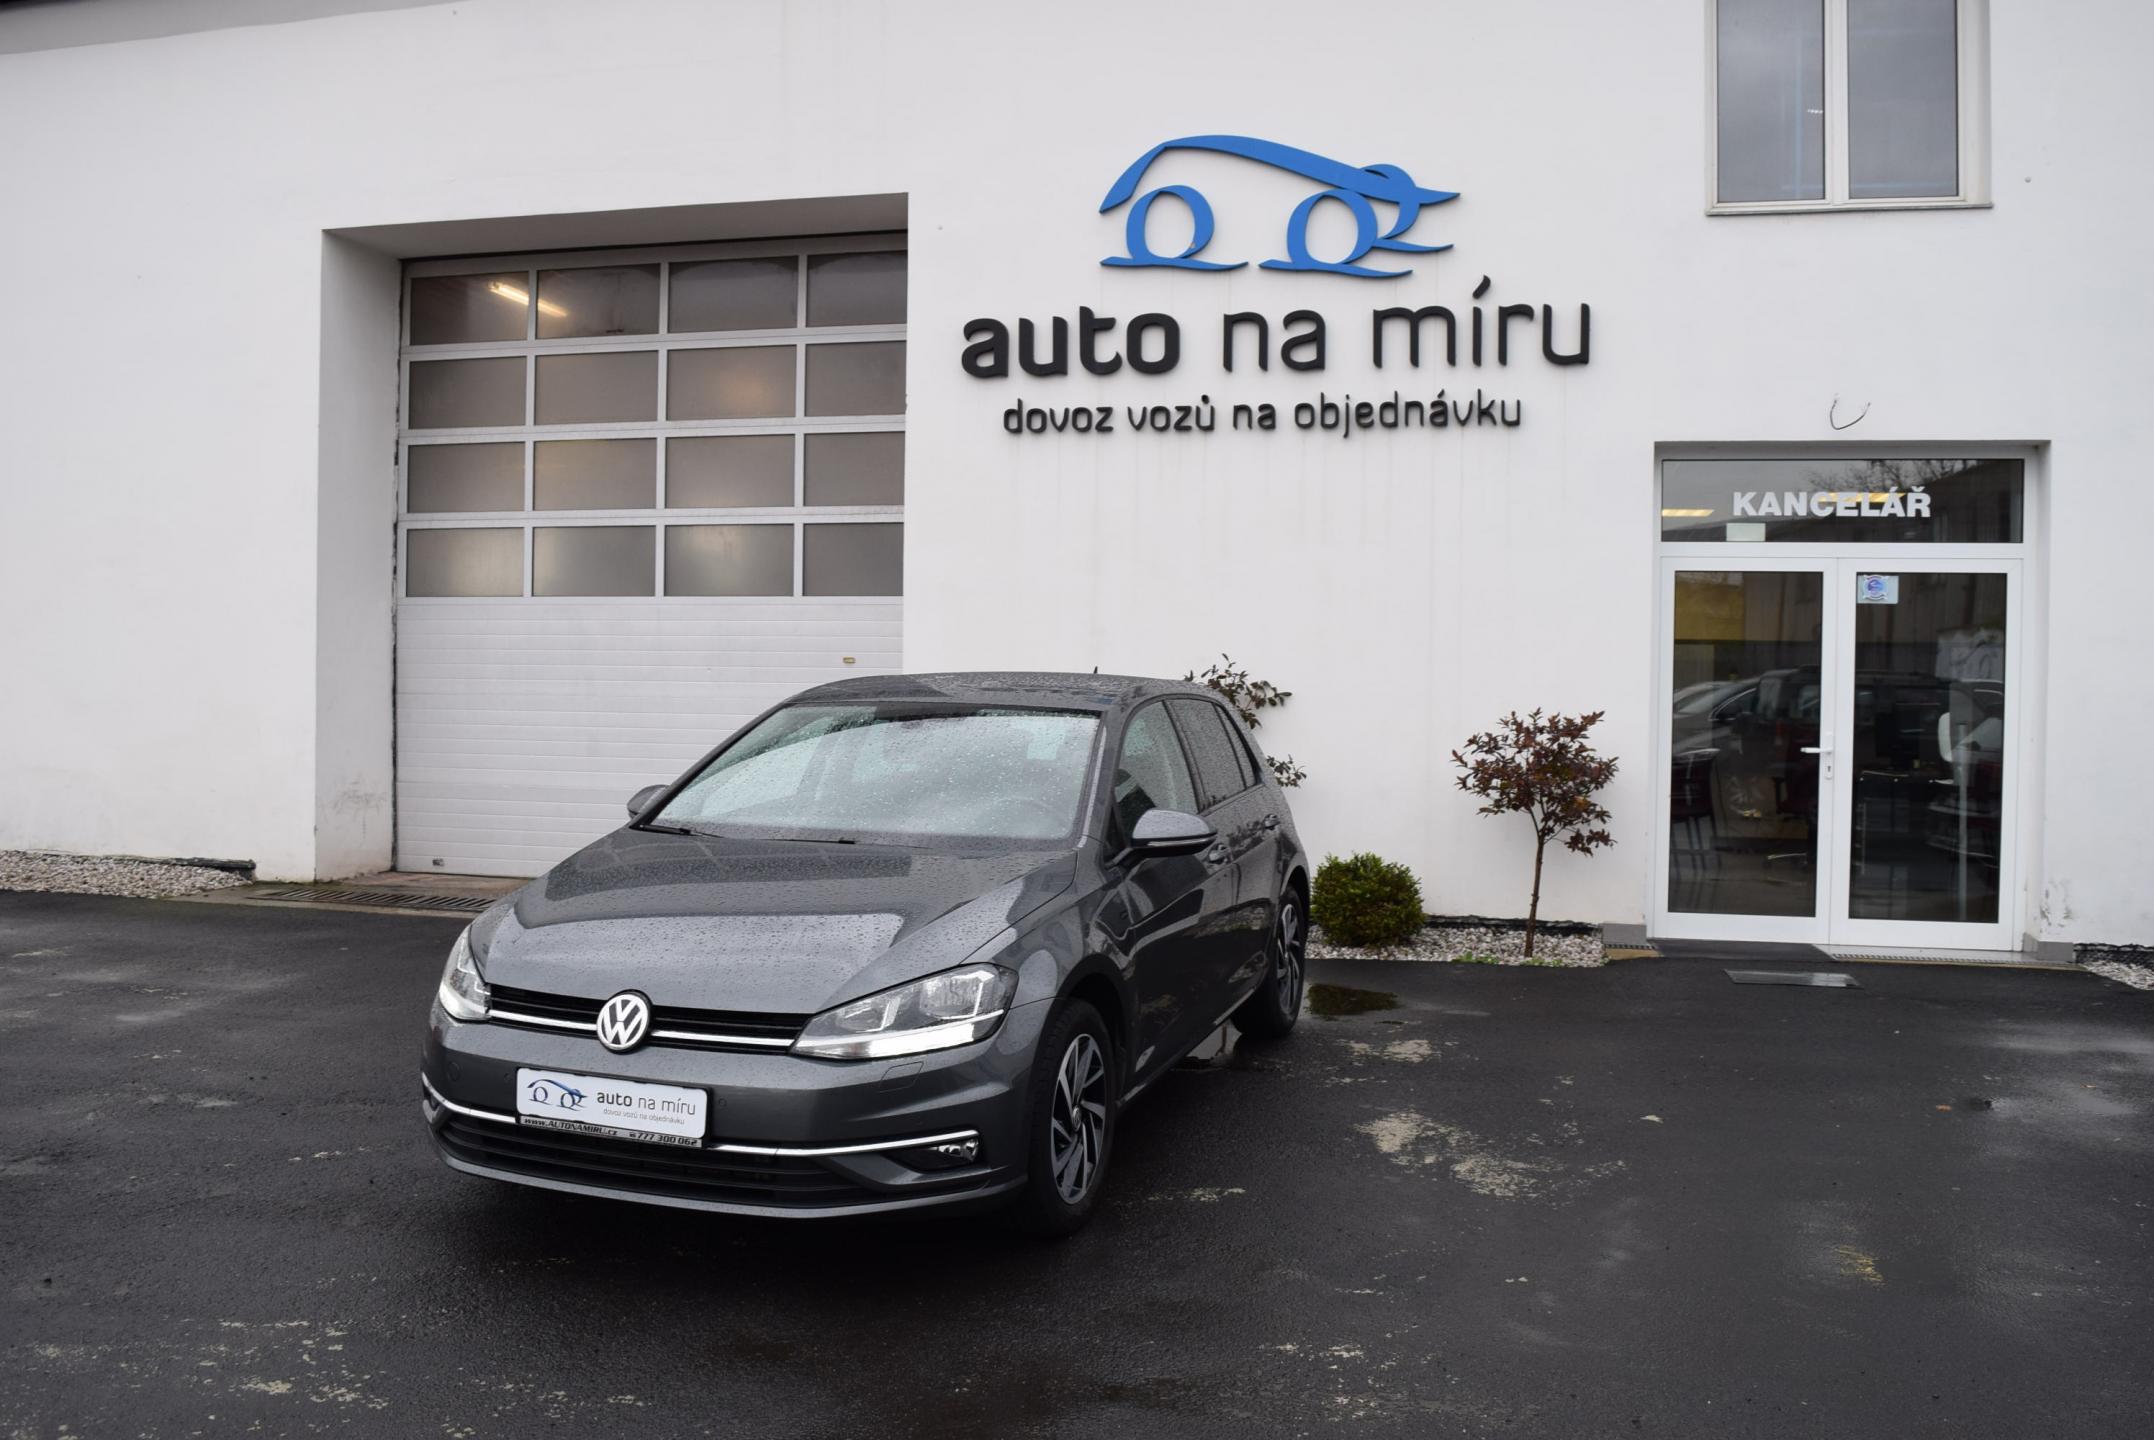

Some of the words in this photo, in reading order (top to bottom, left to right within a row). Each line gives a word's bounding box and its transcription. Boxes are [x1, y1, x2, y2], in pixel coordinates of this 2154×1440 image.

[961, 305, 1180, 378] auto
[1223, 309, 1326, 372] na
[1372, 275, 1591, 368] míru
[1003, 397, 1114, 434] dovoz
[1126, 394, 1216, 432] vozů
[1232, 403, 1277, 430] na
[1294, 389, 1522, 438] objednávku
[1733, 485, 1932, 518] KANCELÁŘ
[597, 1091, 633, 1107] auto
[638, 1097, 656, 1110] na
[661, 1097, 696, 1116] míru
